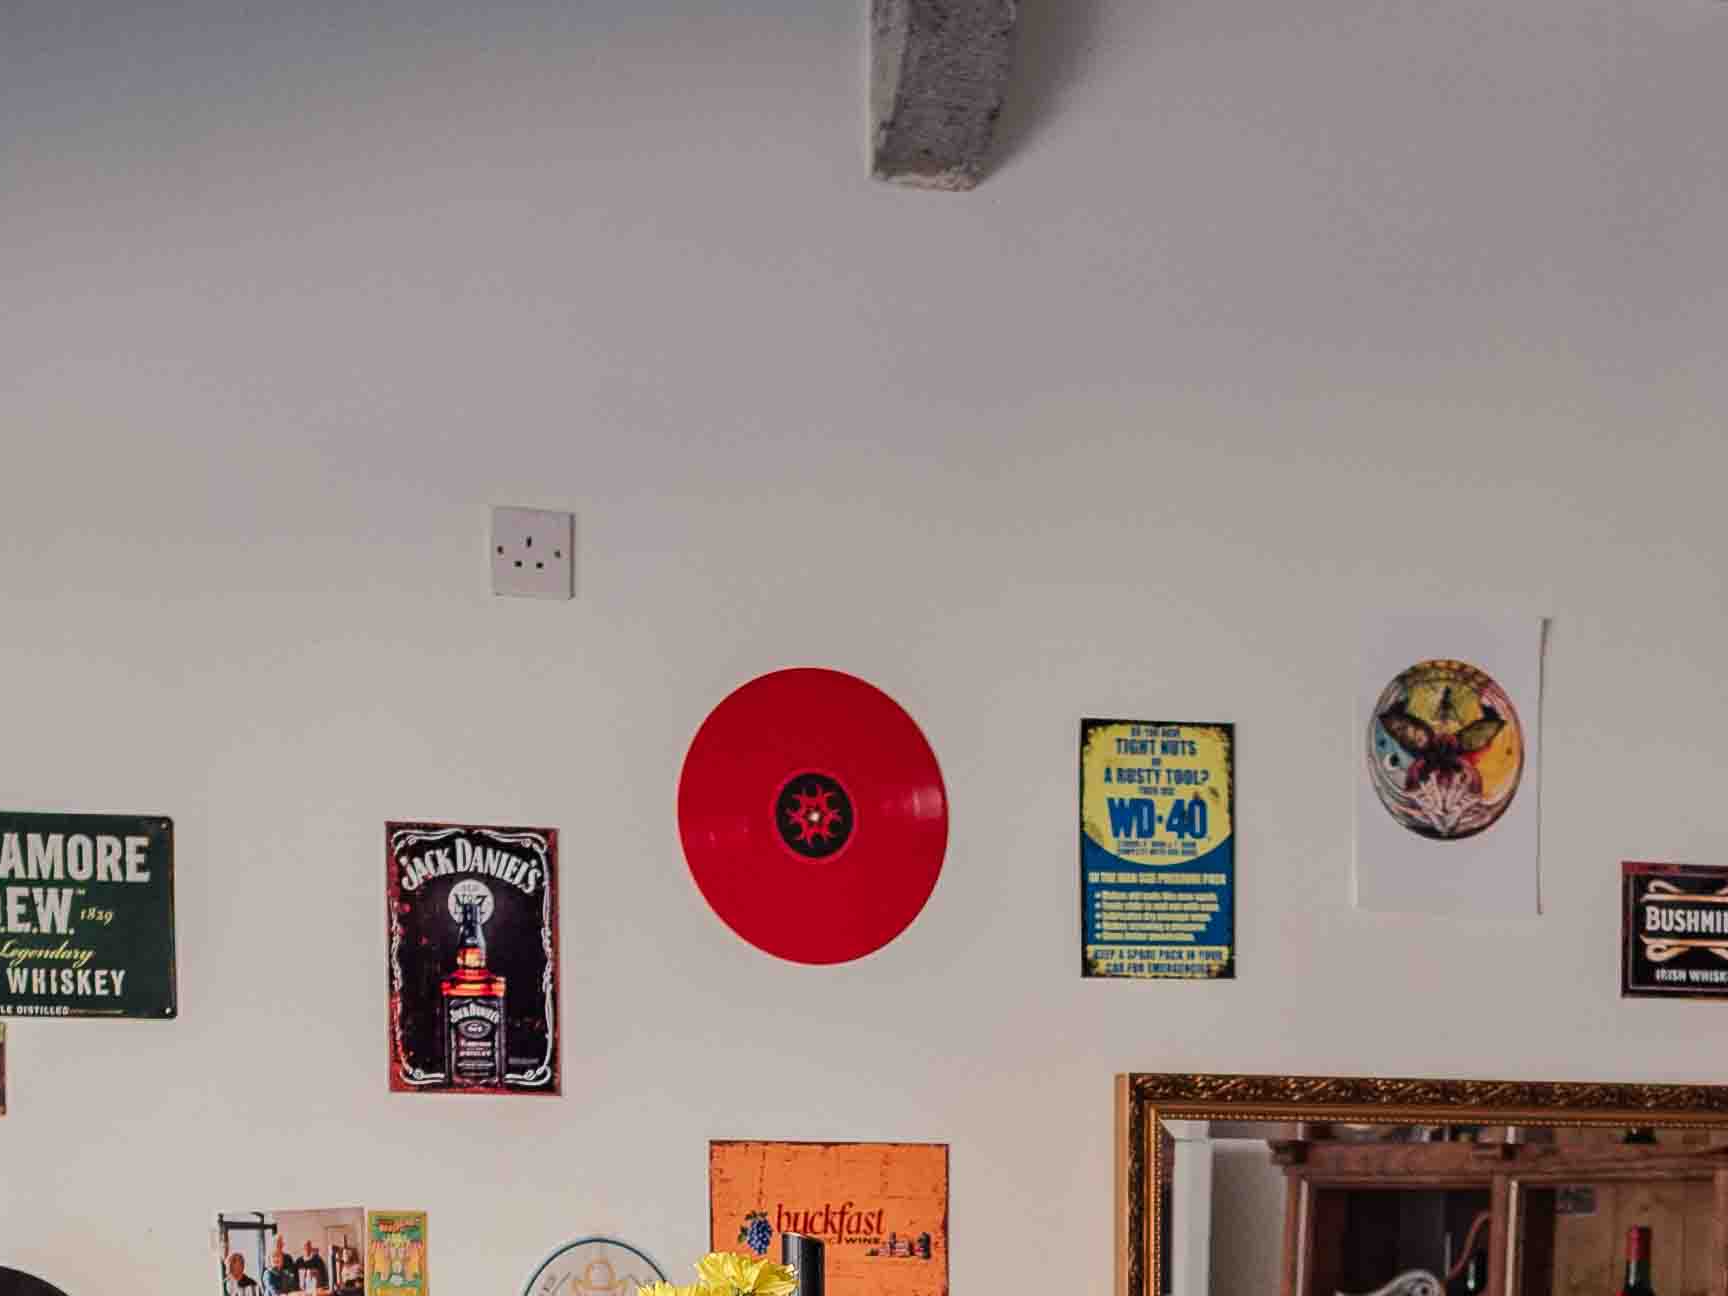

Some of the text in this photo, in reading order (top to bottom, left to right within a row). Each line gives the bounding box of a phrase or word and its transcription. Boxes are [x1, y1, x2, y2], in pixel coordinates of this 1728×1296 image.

[1116, 738, 1156, 756] TIGHT
[400, 836, 542, 895] JACK DANIEL'S
[6, 966, 126, 997] WHISKEY
[1655, 967, 1687, 982] IRISH
[16, 1004, 71, 1016] DISTILLED
[776, 1201, 885, 1244] buckfast
[844, 1236, 882, 1245] WINE
